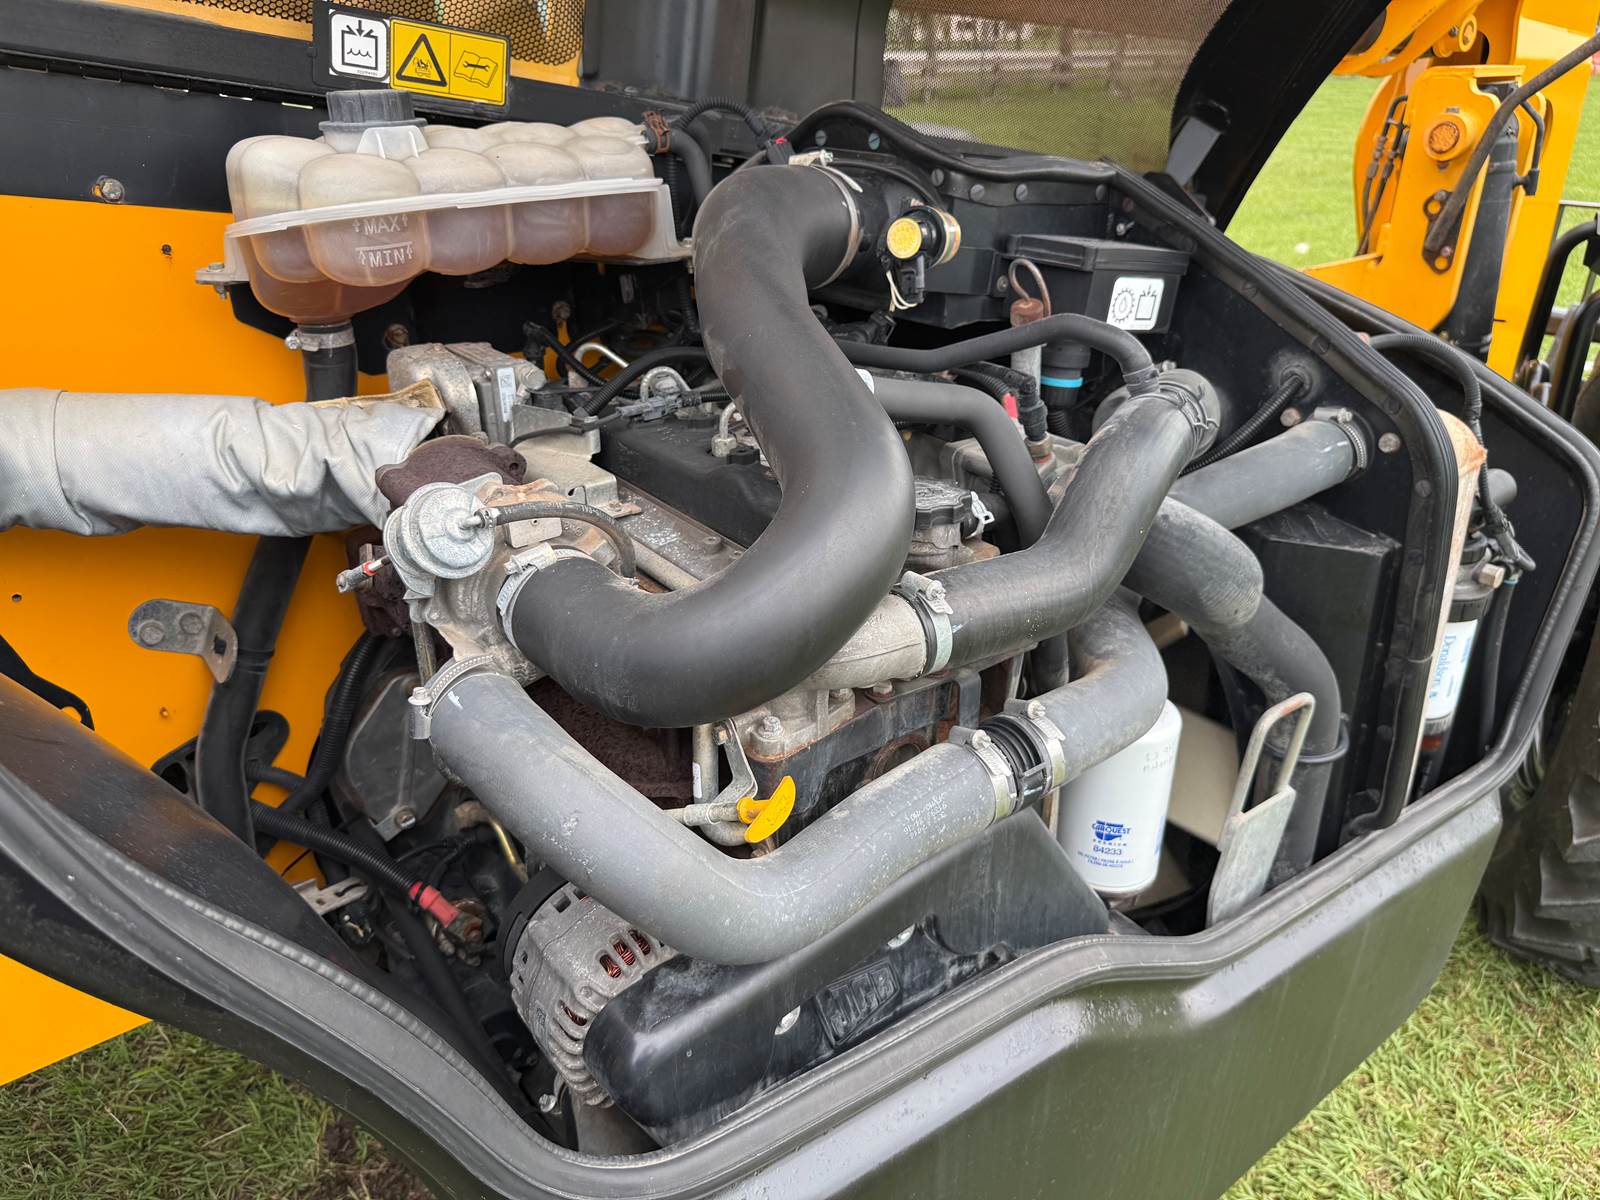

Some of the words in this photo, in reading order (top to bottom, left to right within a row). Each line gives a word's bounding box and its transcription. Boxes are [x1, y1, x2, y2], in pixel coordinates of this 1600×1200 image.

[363, 216, 400, 235] MAX
[369, 248, 405, 267] MIN
[1092, 845, 1122, 856] 84233
